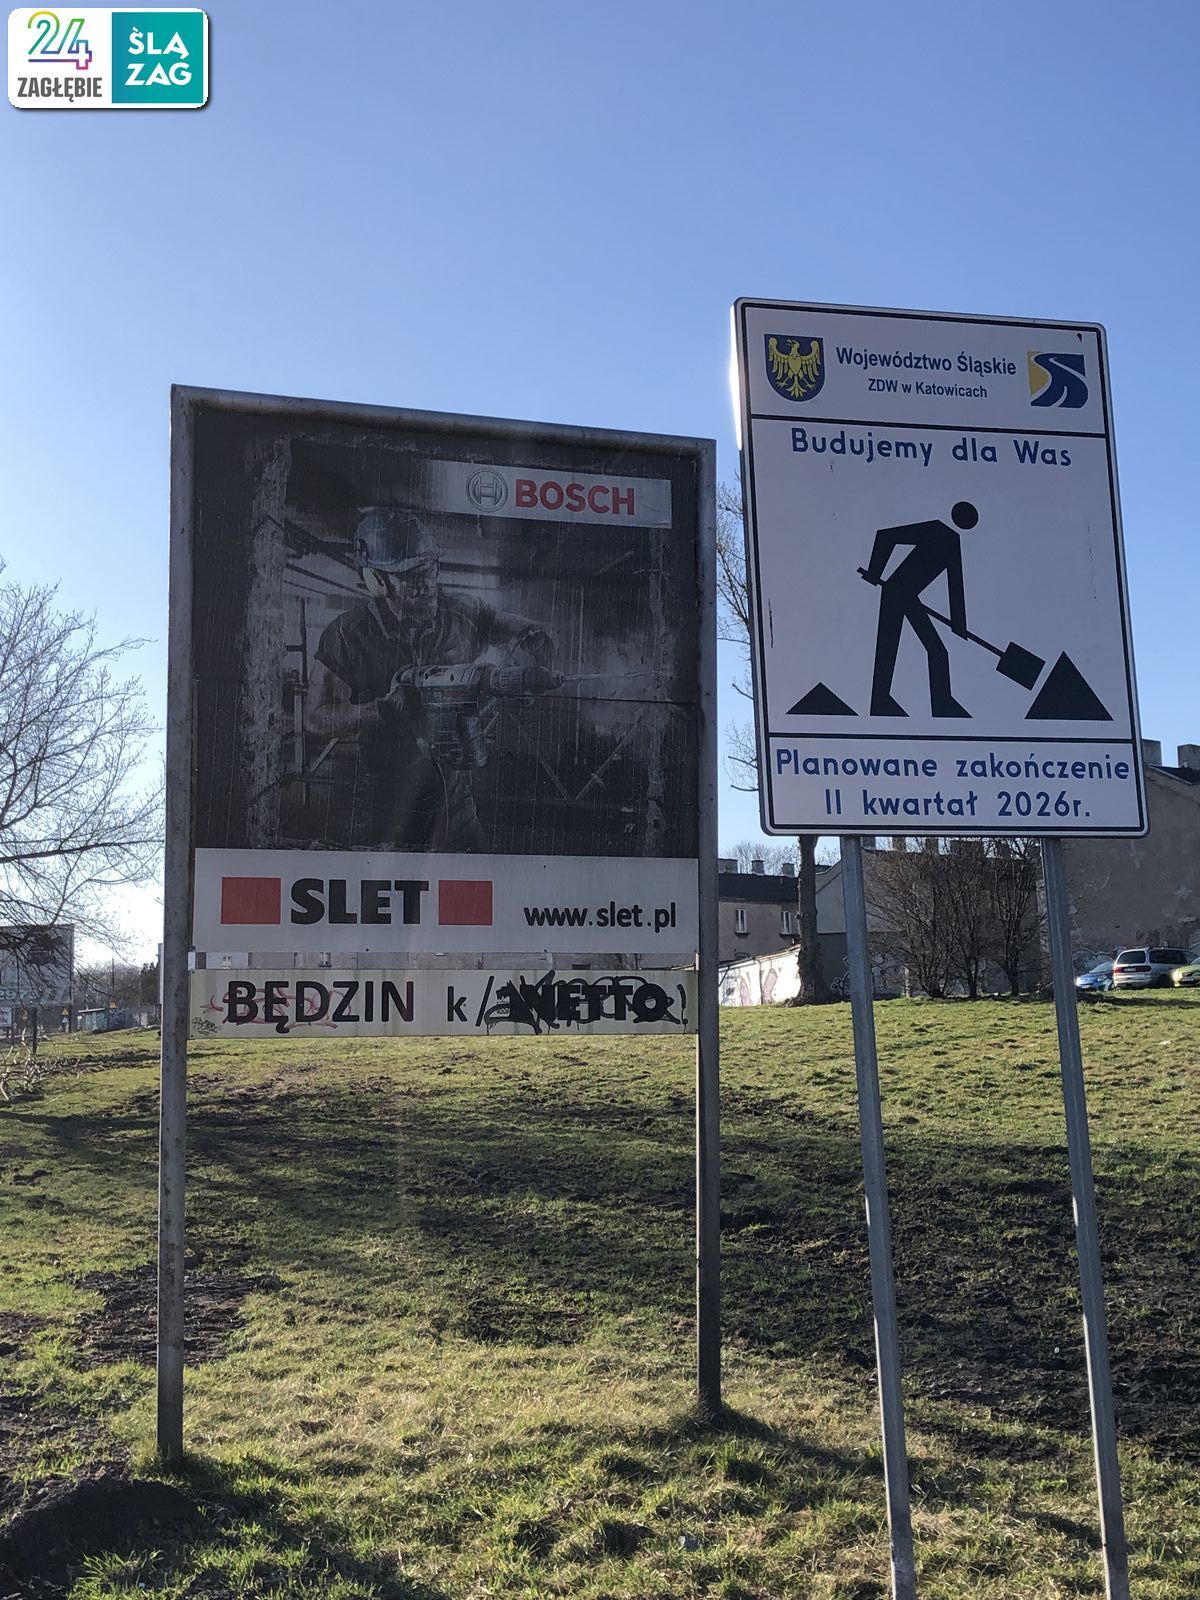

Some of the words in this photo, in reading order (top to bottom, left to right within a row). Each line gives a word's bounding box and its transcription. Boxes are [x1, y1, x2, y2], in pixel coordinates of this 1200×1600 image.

[835, 346, 953, 373] Województwo
[957, 350, 1017, 378] Śląskie
[867, 378, 898, 393] ZDW
[901, 384, 912, 394] w
[915, 382, 988, 399] Katowicach
[791, 427, 933, 467] Budujemy
[951, 437, 998, 464] dla
[1013, 439, 1072, 467] Was
[515, 478, 635, 516] BOSCH
[776, 748, 938, 779] Planowane
[956, 752, 1130, 780] zakończenie
[825, 789, 842, 815] II
[862, 789, 977, 817] kwartał
[997, 791, 1091, 818] 2026r.
[290, 878, 429, 925] SLET
[524, 901, 677, 933] www.slet.pl
[227, 980, 414, 1034] BĘDZIN
